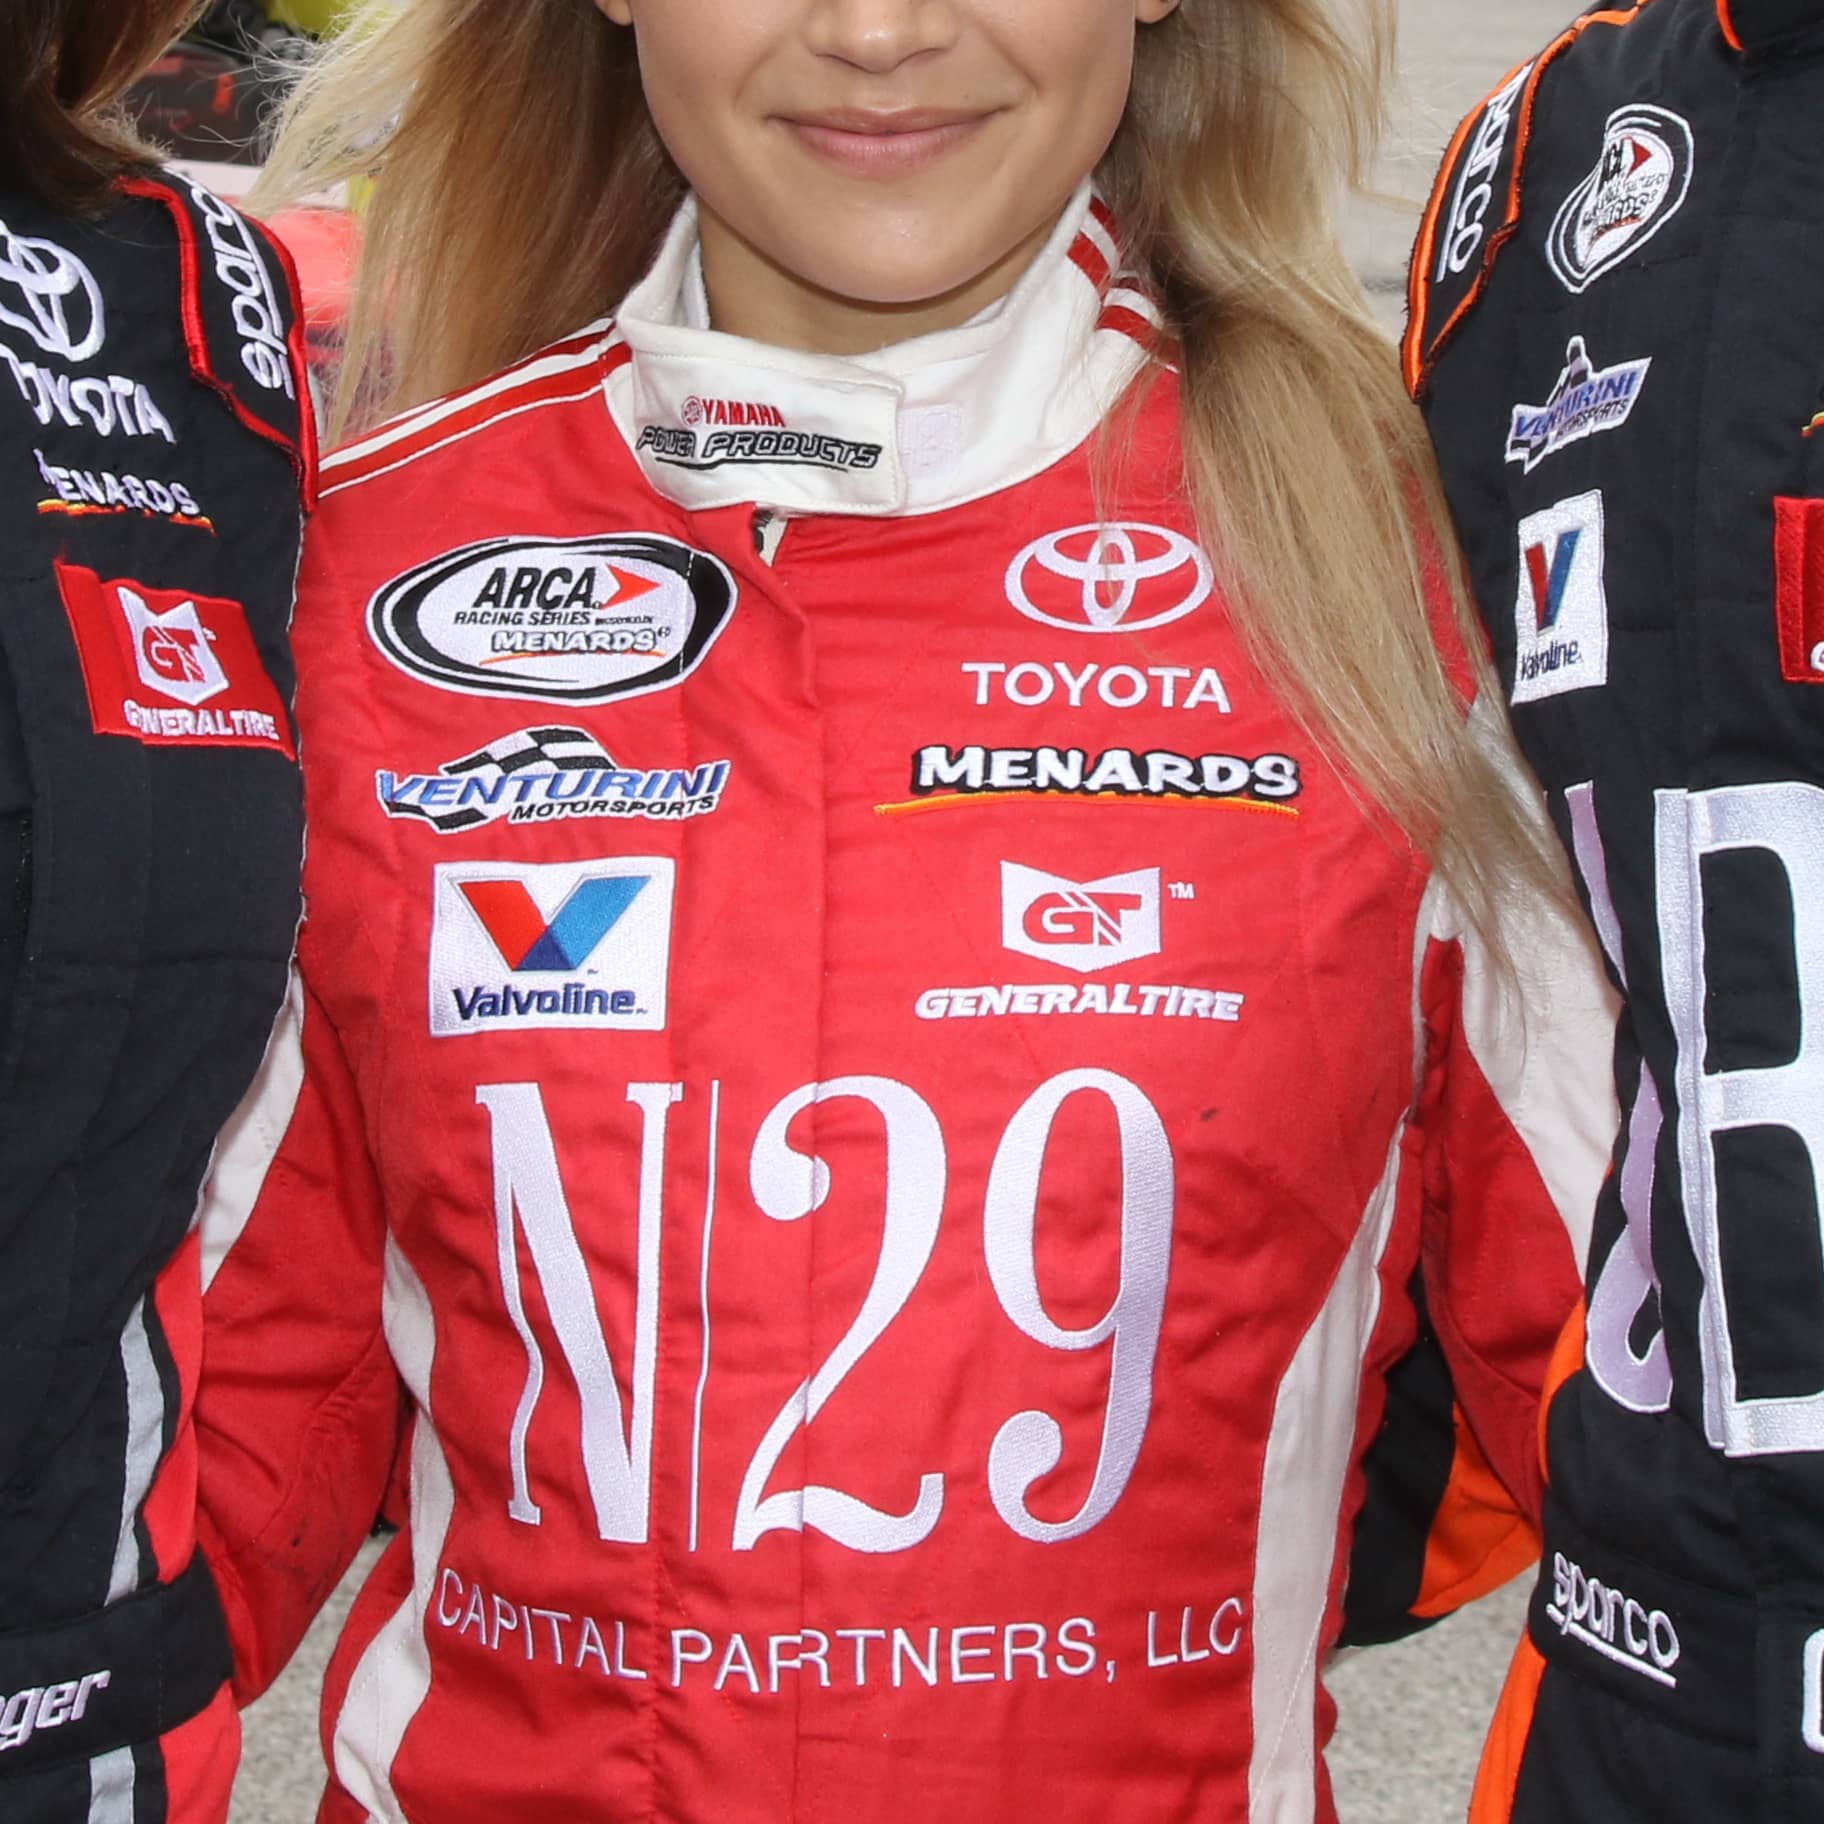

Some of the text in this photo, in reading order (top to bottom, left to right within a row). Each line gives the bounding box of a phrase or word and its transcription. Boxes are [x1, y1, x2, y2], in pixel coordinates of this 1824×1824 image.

[702, 398, 787, 427] YAMAHA
[636, 425, 883, 469] POWER PRODUCTS
[473, 566, 597, 609] ARCA
[453, 610, 524, 626] RACING
[527, 610, 591, 626] SERIES
[491, 628, 657, 653] MENARDS
[960, 661, 1232, 714] TOYOTA
[377, 762, 729, 806] VENTURINI
[911, 744, 1301, 799] MENARDS
[509, 795, 716, 821] MOTORSPORTS
[451, 982, 637, 1021] Valvoline
[437, 1567, 1245, 1693] CAPITAL PARTNERS, LLC
[1552, 1551, 1680, 1669] sparco
